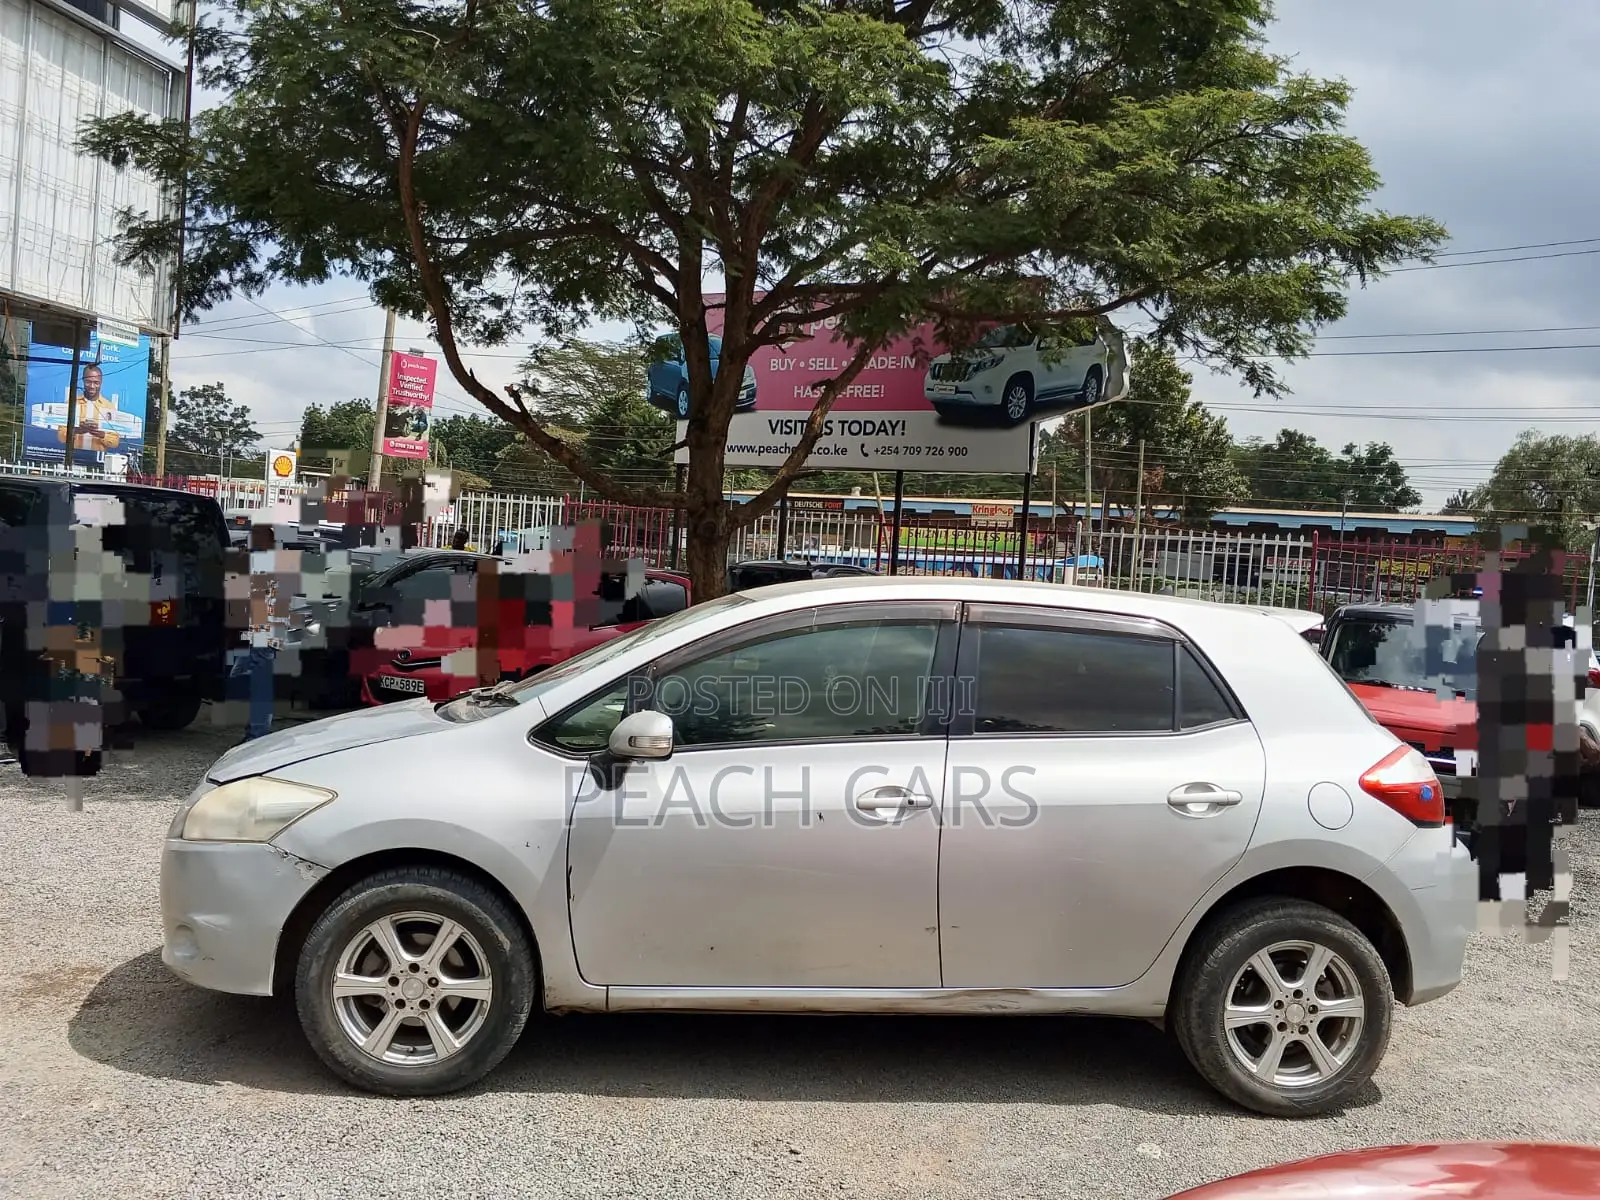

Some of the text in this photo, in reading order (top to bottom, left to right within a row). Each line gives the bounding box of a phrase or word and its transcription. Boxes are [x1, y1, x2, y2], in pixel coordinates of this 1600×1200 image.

[62, 347, 84, 358] Coy
[770, 356, 916, 371] BUY SELL ADE-IN
[397, 372, 428, 385] Inspected.
[400, 381, 425, 392] Verified.
[794, 385, 885, 398] HAS-FREE!
[392, 387, 430, 402] Trustworthy!
[768, 419, 808, 435] VISIT
[838, 420, 906, 436] TODAY!
[874, 446, 899, 456] +254
[902, 446, 922, 456] 709
[925, 446, 945, 457] 726
[948, 446, 968, 457] 900
[794, 501, 824, 509] DEUTSCHE
[400, 679, 424, 692] 589E
